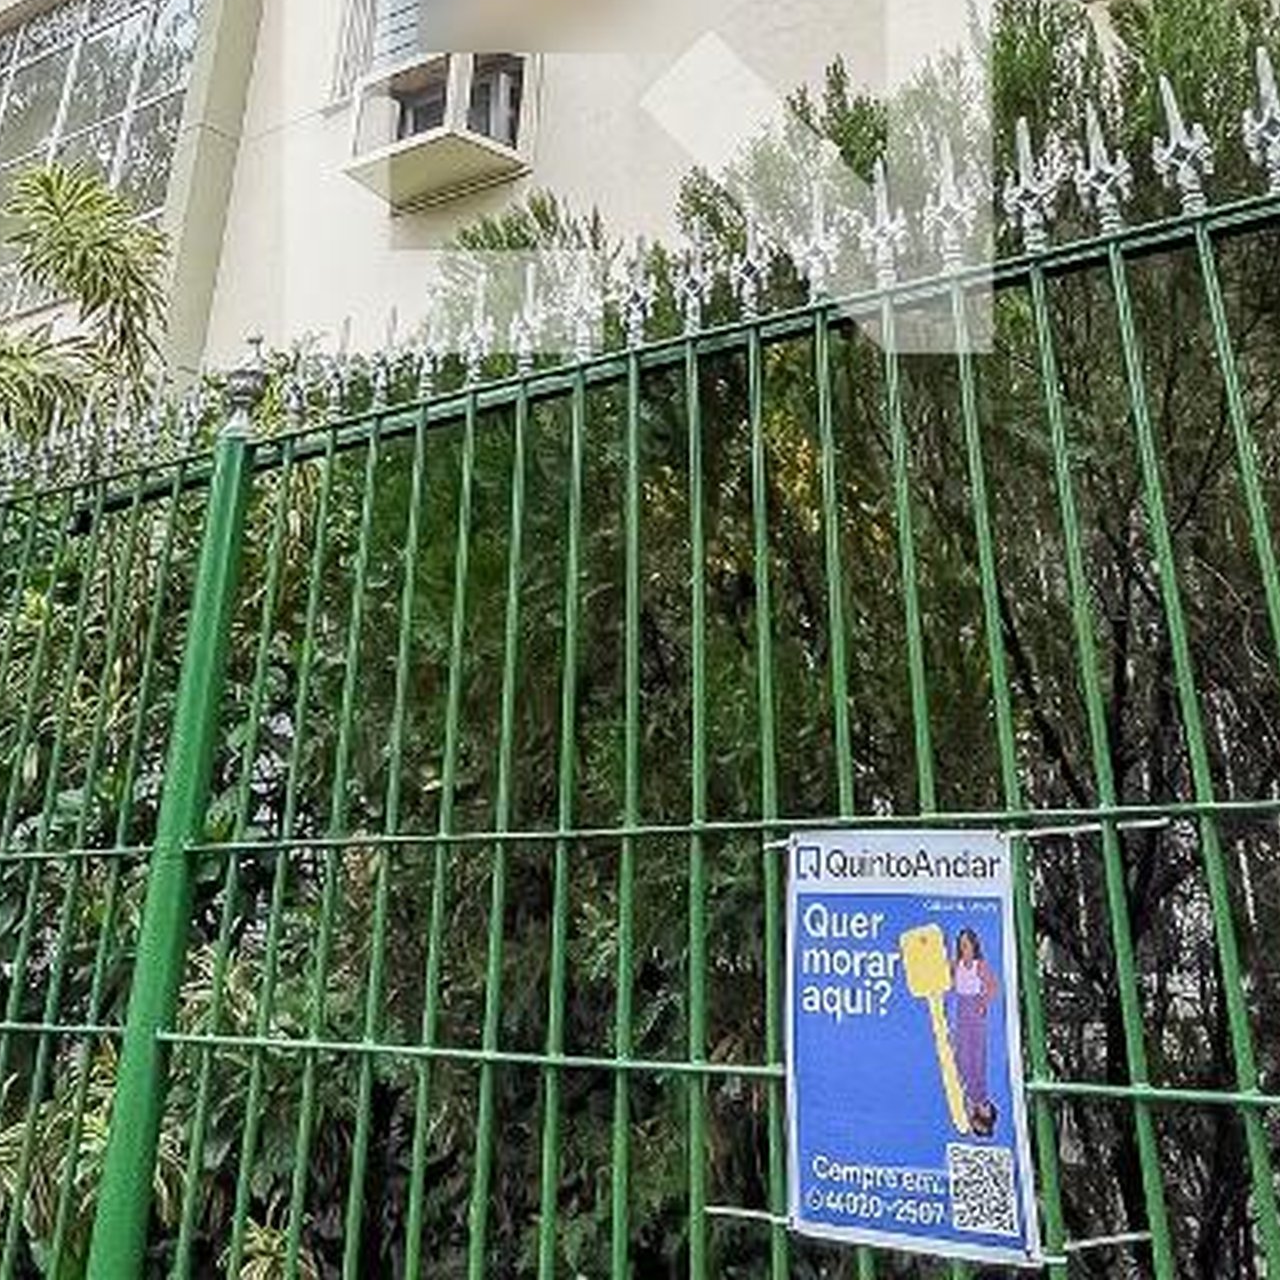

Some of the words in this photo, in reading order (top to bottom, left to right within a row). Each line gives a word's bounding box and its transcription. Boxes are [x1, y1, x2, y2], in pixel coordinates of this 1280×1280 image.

[826, 850, 1001, 878] QuintoAndar
[804, 903, 885, 939] Quer
[803, 948, 900, 978] morar
[802, 980, 892, 1024] aqui?
